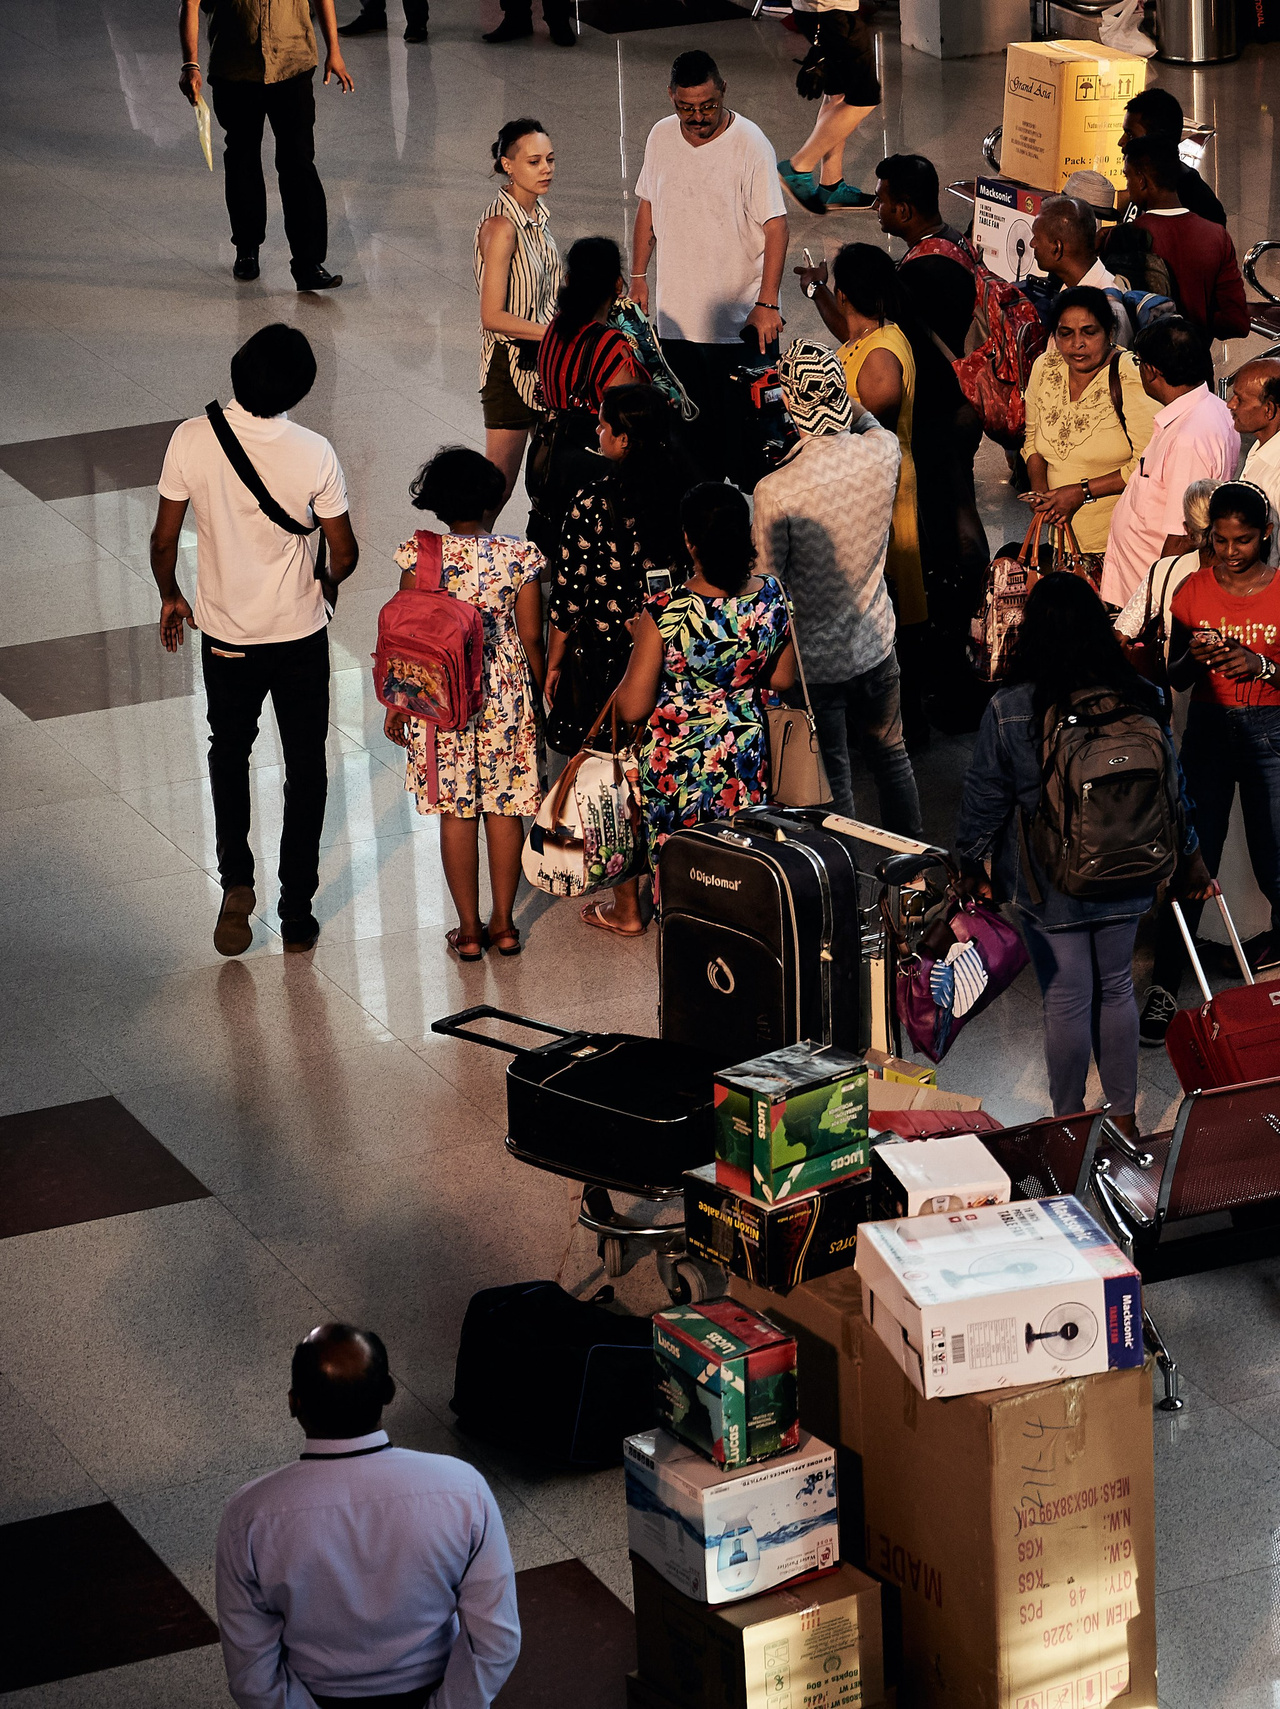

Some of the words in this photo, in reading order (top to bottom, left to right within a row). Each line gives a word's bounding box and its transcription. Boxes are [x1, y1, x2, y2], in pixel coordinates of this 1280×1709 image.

[1009, 76, 1033, 92] Grand
[1033, 84, 1052, 100] Asia
[1064, 157, 1086, 165] Pack
[979, 184, 1012, 203] Macksonic
[979, 210, 994, 219] PREMIUM
[979, 216, 991, 227] TABLE
[991, 220, 1000, 229] FAN
[696, 870, 741, 891] Diplomat
[757, 1101, 768, 1140] Lucas
[830, 1149, 864, 1171] Lucas
[734, 1218, 760, 1241] Nixon
[997, 1210, 1019, 1227] TABLE
[1048, 1200, 1091, 1243] Macksonic
[1109, 1305, 1118, 1328] TABLE
[1122, 1294, 1135, 1350] Macksonic
[657, 1330, 681, 1359] Lucas
[705, 1331, 737, 1354] Lucas
[727, 1424, 740, 1464] Lucas
[769, 1463, 806, 1479] APPLIANCES
[805, 1458, 823, 1468] HOME
[1019, 1507, 1036, 1529] CM
[799, 1554, 816, 1564] Water
[1018, 1537, 1043, 1562] KGS
[776, 1559, 799, 1570] Purifier
[879, 1534, 942, 1608] MADE
[1018, 1568, 1044, 1593] KGS
[1069, 1586, 1087, 1607] 48
[1019, 1600, 1043, 1625] PCS
[1106, 1600, 1133, 1627] ITEM
[1043, 1623, 1073, 1648] 3226
[806, 1681, 822, 1690] 80g
[832, 1669, 858, 1682] 80pkts
[850, 1680, 863, 1690] NET
[839, 1686, 849, 1694] WT
[841, 1692, 863, 1705] GROSS
